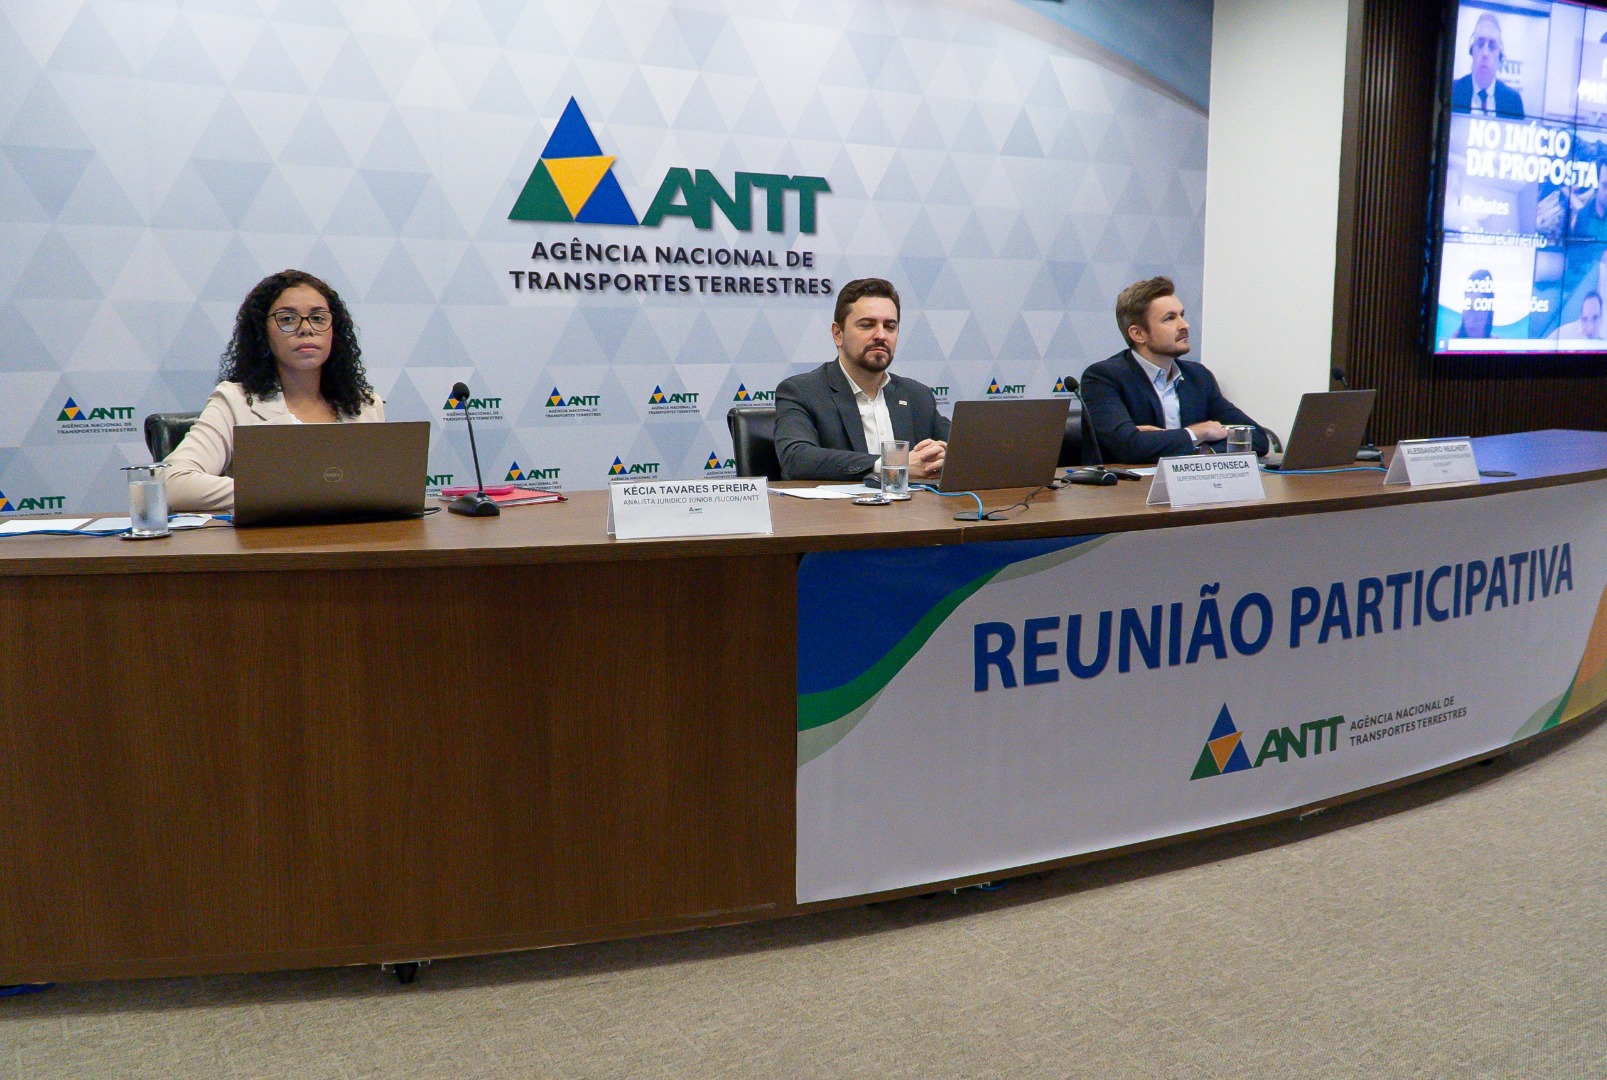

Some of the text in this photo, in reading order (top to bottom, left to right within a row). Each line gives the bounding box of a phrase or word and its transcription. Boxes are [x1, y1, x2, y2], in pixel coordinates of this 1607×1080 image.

[1467, 118, 1571, 158] NO INÍCIO
[1466, 148, 1599, 189] DA PROPOSTA
[640, 167, 832, 233] ANTT
[1461, 194, 1510, 216] Debates
[531, 237, 813, 267] AGÊNCIA NACIONAL DE
[509, 271, 832, 295] TRANSPORTES TERRESTRES
[930, 387, 949, 395] NTT
[1002, 385, 1026, 393] ANTT
[567, 395, 600, 406] ANTT
[668, 393, 699, 403] ANTT
[752, 391, 776, 401] ANT
[467, 398, 502, 410] ANTT
[88, 407, 136, 420] ANTT
[628, 463, 660, 474] ANTT
[1172, 461, 1250, 472] MARCELO FONSECA
[426, 474, 453, 486] NTT
[527, 468, 561, 480] ANTT
[623, 483, 757, 496] KÉCIA TAVARES PEREIRA
[17, 496, 66, 511] ANTT
[973, 542, 1574, 692] REUNIÃO PARTICIPATIVA
[1350, 696, 1455, 732] AGÊNCIA NACIONAL DE
[1350, 707, 1467, 747] TRANSPORTES TERRESTRES
[1253, 715, 1345, 768] ANTT
